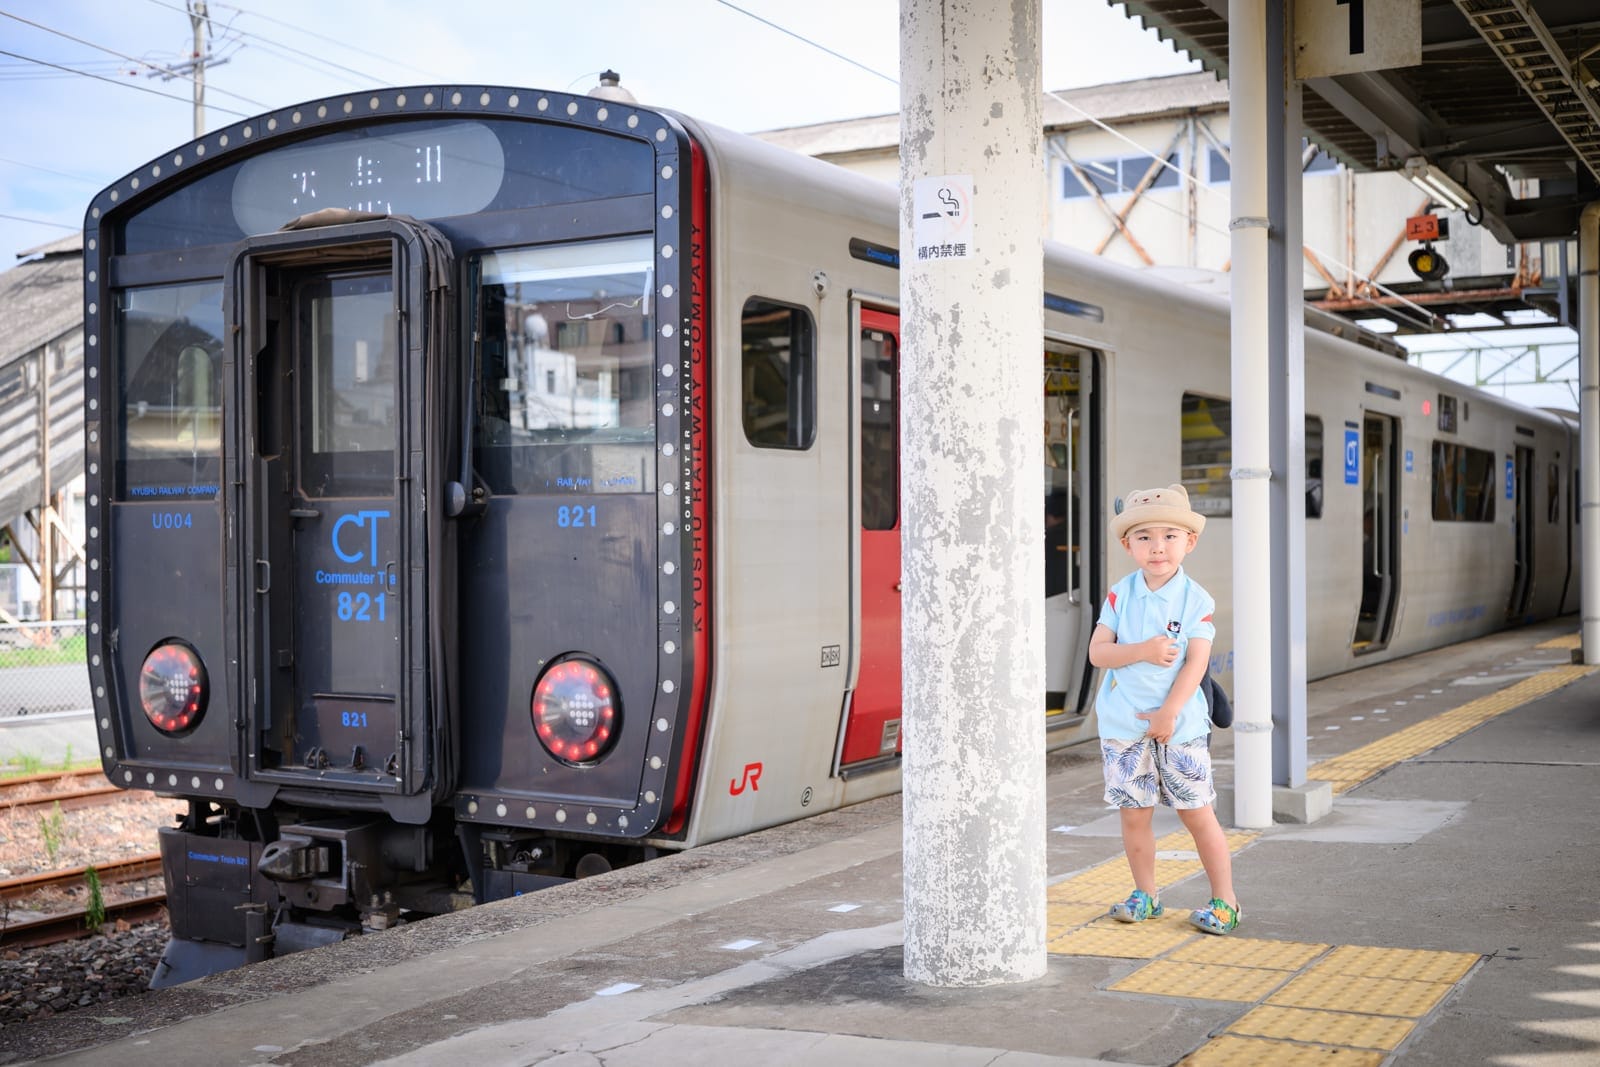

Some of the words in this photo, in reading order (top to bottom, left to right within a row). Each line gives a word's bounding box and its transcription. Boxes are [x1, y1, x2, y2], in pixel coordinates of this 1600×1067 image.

[1336, 0, 1364, 55] 1
[918, 243, 967, 260] 構内禁煙
[692, 224, 702, 364] COMPANY
[692, 379, 702, 502] RAILWAY
[132, 487, 157, 496] KYUSHU
[158, 486, 186, 496] RAILWAY
[187, 485, 219, 495] COMPANY
[152, 512, 193, 529] U004
[557, 505, 597, 528] 821
[332, 510, 391, 567] CT
[315, 570, 375, 585] Commuter
[692, 517, 703, 632] KYUSHU
[337, 591, 386, 622] 821
[342, 711, 368, 728] 821
[729, 762, 763, 796] JR
